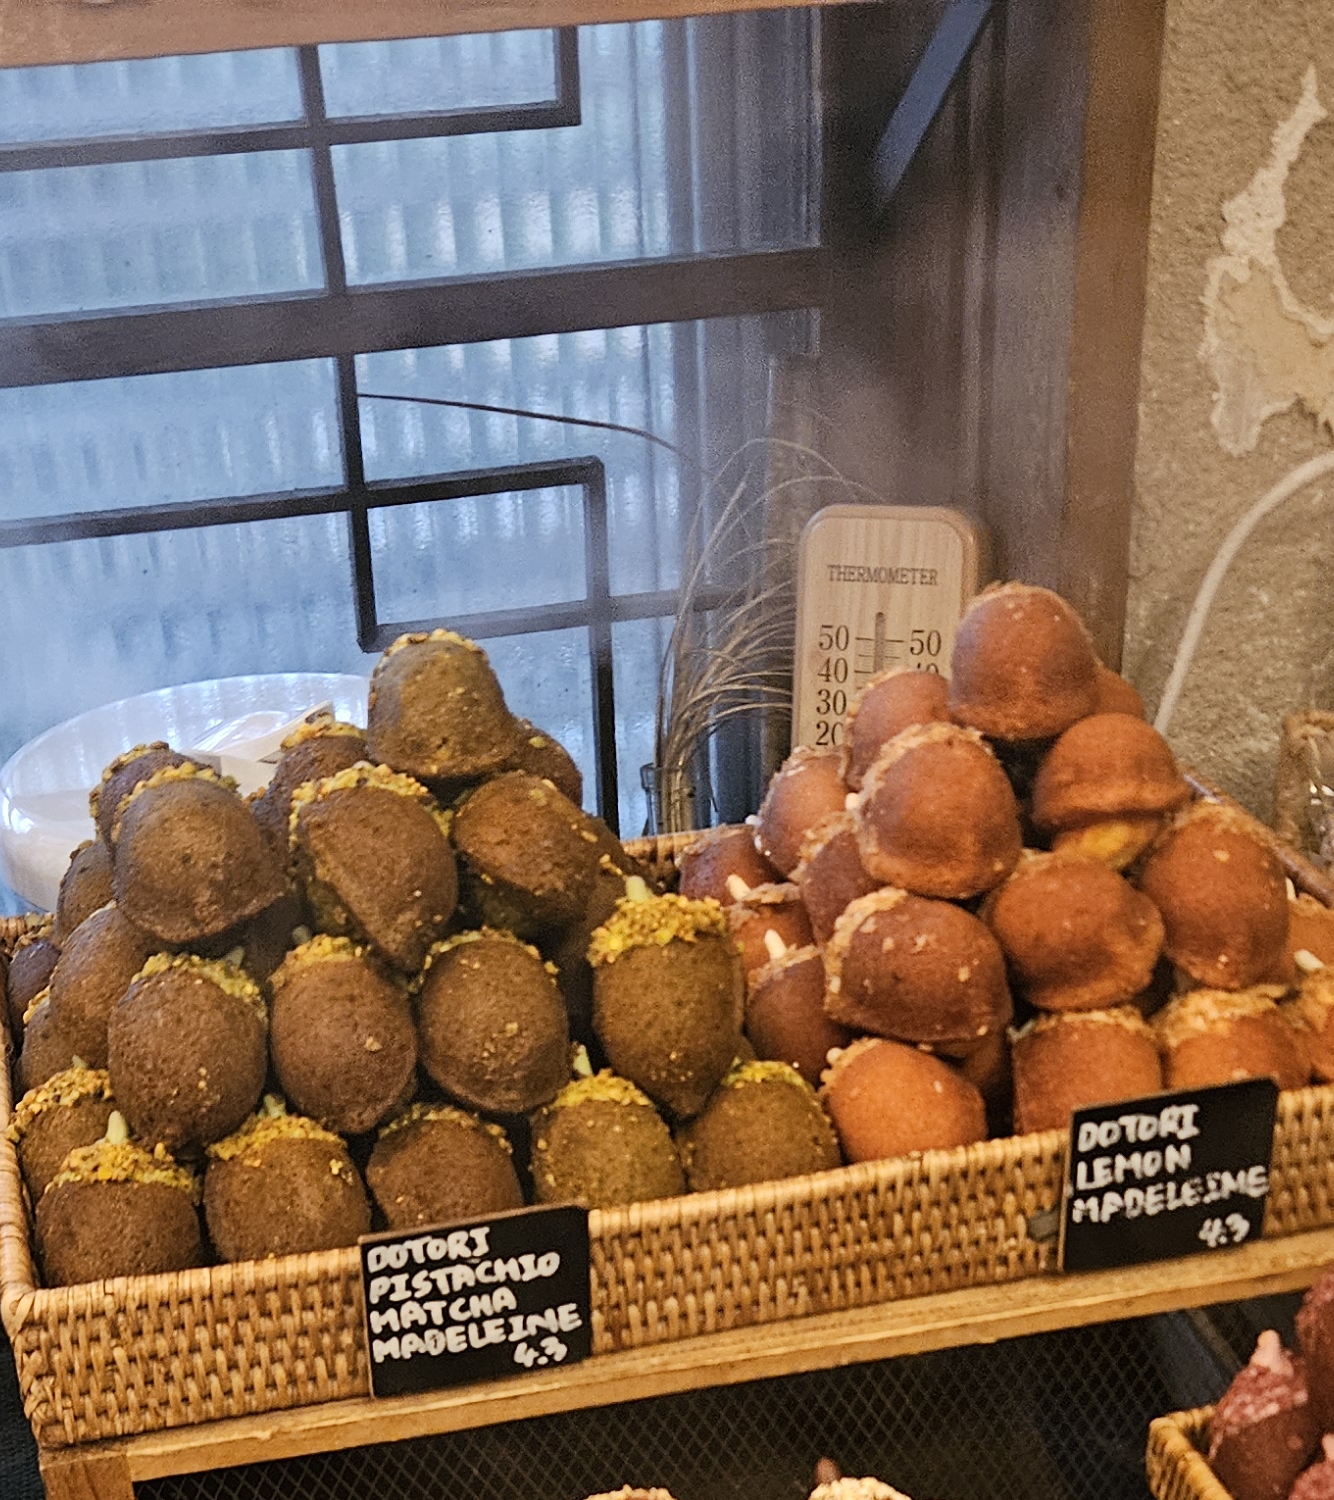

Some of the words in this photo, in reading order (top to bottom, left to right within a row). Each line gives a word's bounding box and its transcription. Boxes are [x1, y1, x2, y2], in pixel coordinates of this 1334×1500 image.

[827, 564, 939, 586] THERMOMETER
[818, 624, 850, 651] 50
[909, 629, 942, 657] 50
[817, 657, 848, 684] 40
[816, 689, 847, 716] 30
[1077, 1103, 1200, 1153] DOTORI
[1075, 1143, 1192, 1191] LEMON
[1071, 1165, 1270, 1224] MADELEINE
[367, 1226, 491, 1273] DOTORI
[369, 1251, 561, 1304] PISTACHIO
[369, 1286, 517, 1334] MATCHA
[371, 1302, 583, 1364] MADELEINE
[513, 1335, 568, 1368] 4.3
